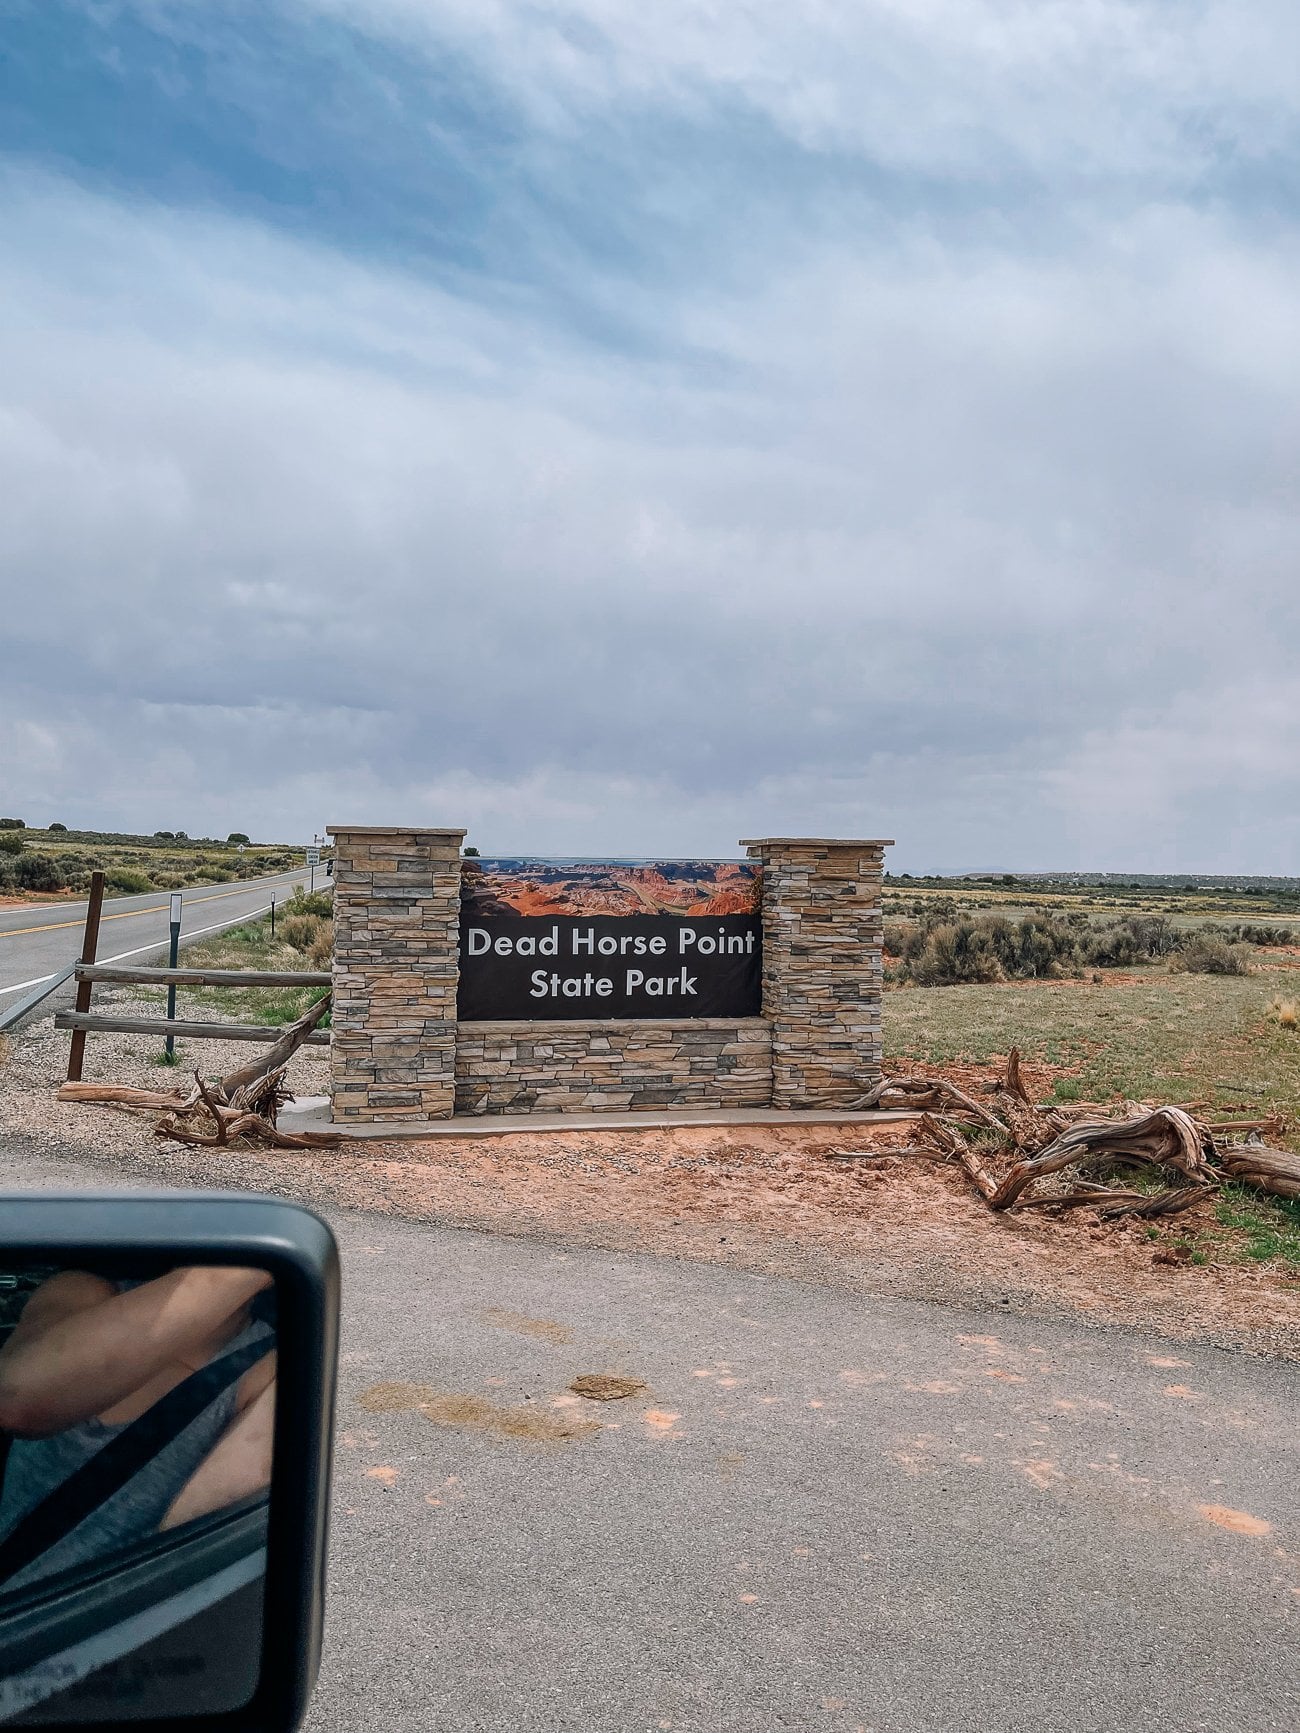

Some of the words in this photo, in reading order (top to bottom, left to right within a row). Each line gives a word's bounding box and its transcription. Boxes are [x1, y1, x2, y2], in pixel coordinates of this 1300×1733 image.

[468, 926, 559, 956] Dead
[572, 928, 667, 956] Horse
[679, 927, 755, 955] Point
[529, 969, 614, 998] State
[626, 966, 698, 996] Park
